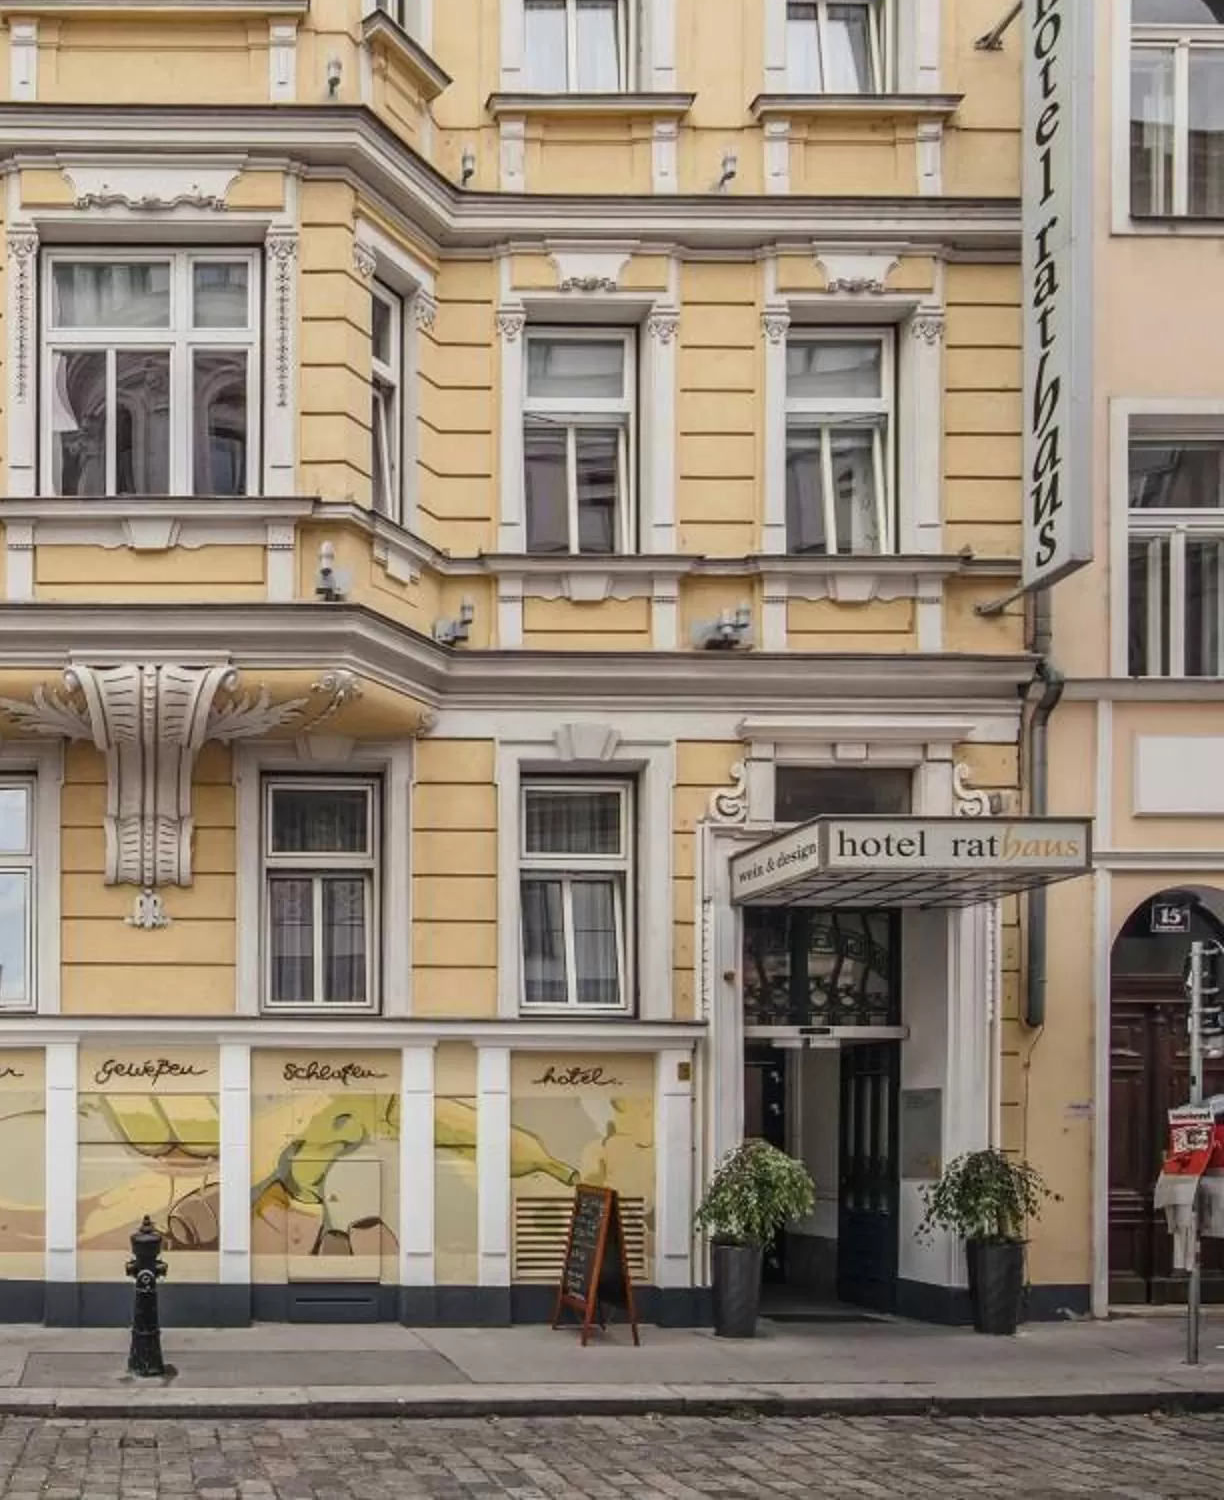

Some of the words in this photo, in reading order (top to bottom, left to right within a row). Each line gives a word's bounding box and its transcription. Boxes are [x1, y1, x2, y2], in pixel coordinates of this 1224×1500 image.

[1031, 216, 1062, 568] rathaus
[777, 843, 817, 869] design
[838, 830, 926, 857] hotel
[951, 826, 1079, 861] rathaus
[1160, 907, 1182, 924] 15
